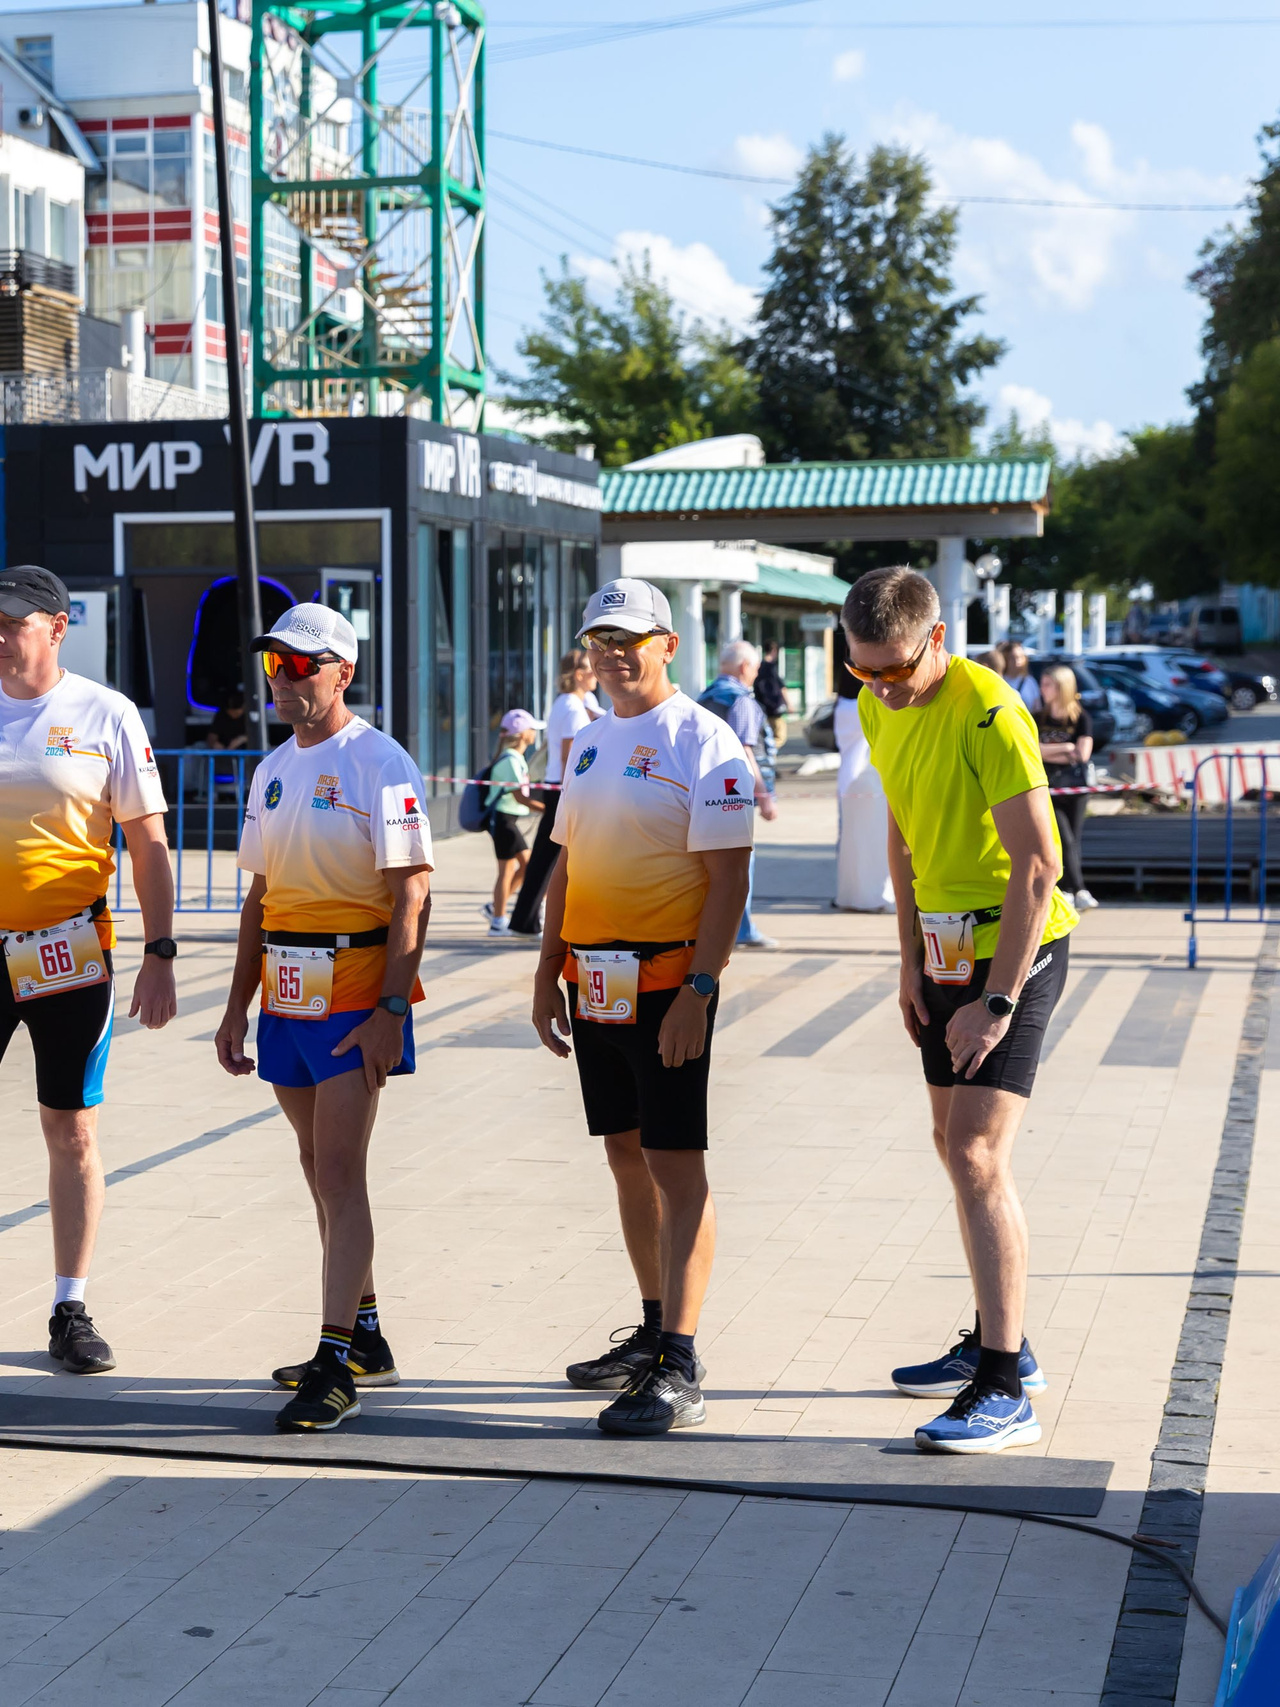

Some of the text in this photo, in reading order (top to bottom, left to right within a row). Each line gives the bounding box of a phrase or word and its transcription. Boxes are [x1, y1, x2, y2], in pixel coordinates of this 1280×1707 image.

[74, 421, 330, 492] МИР VR
[419, 439, 456, 493] МИР
[452, 433, 481, 498] VR
[48, 726, 73, 736] ЛАЗЕР
[45, 747, 64, 757] 2025
[632, 745, 658, 758] ЛАЗЕР
[39, 940, 73, 977] 66
[278, 965, 300, 999] 65
